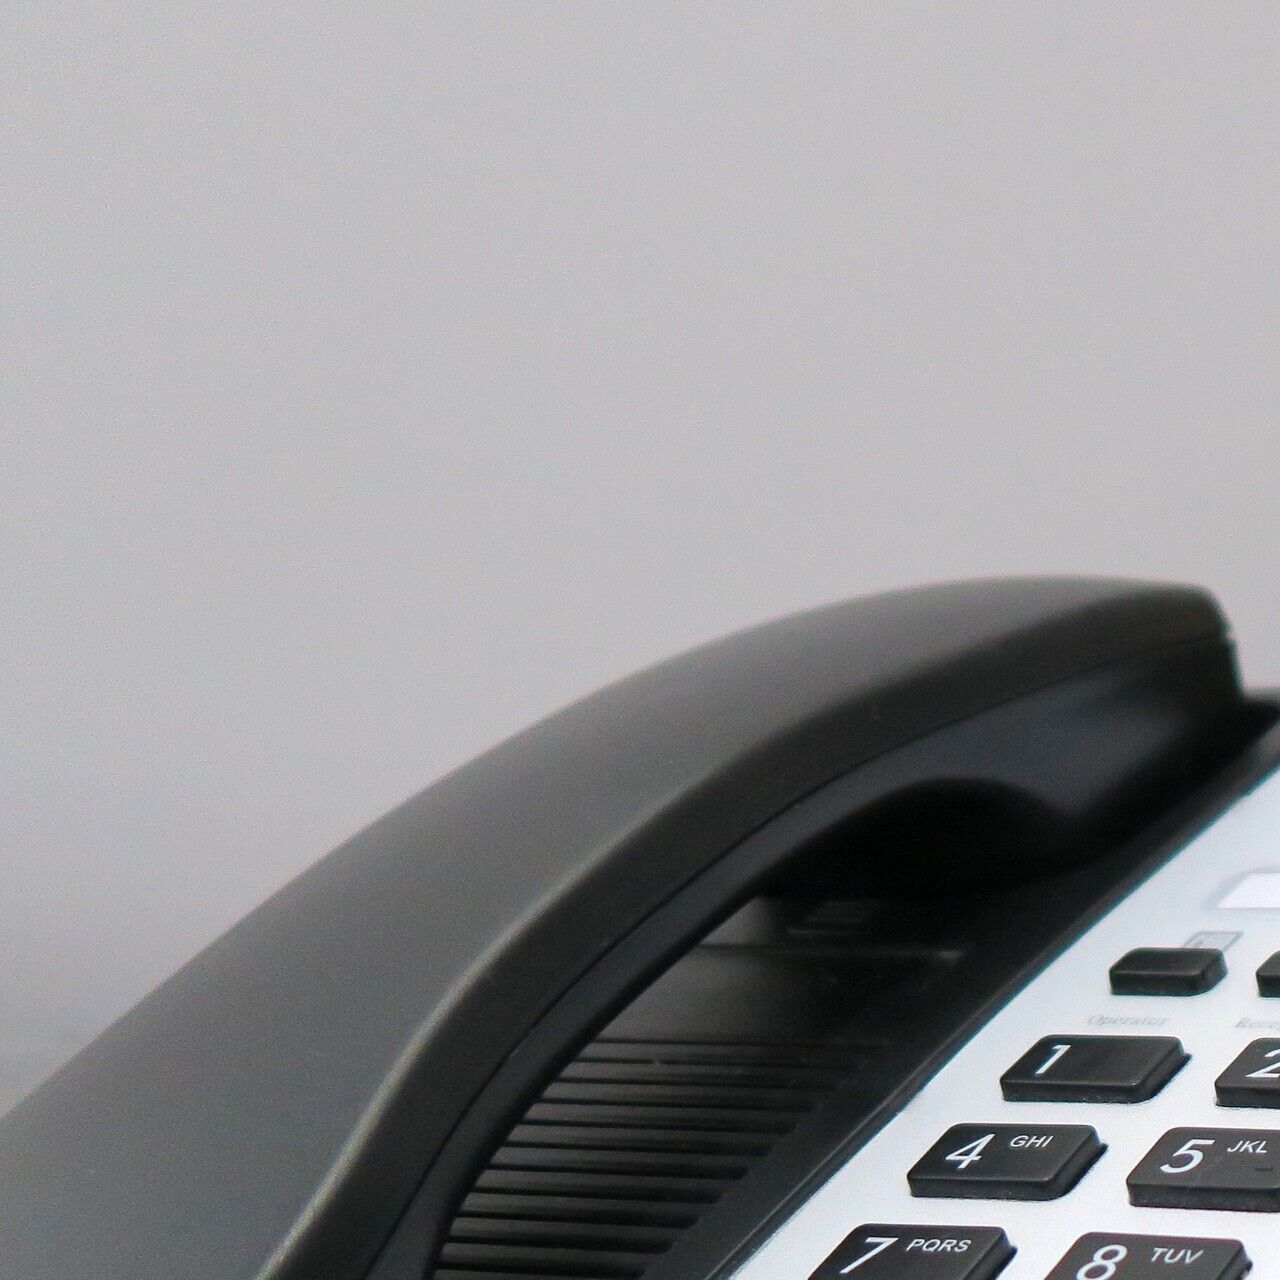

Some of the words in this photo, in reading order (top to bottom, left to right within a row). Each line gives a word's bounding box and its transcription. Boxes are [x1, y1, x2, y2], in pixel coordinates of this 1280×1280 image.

[1087, 1014, 1169, 1028] Operator
[1034, 1044, 1073, 1075] 1
[944, 1133, 996, 1169] 4
[1009, 1135, 1055, 1148] GHI
[1160, 1138, 1217, 1174] 5
[1226, 1140, 1268, 1154] JKL
[839, 1237, 899, 1275] 7
[905, 1238, 972, 1253] PQRS
[1150, 1247, 1205, 1264] TUV
